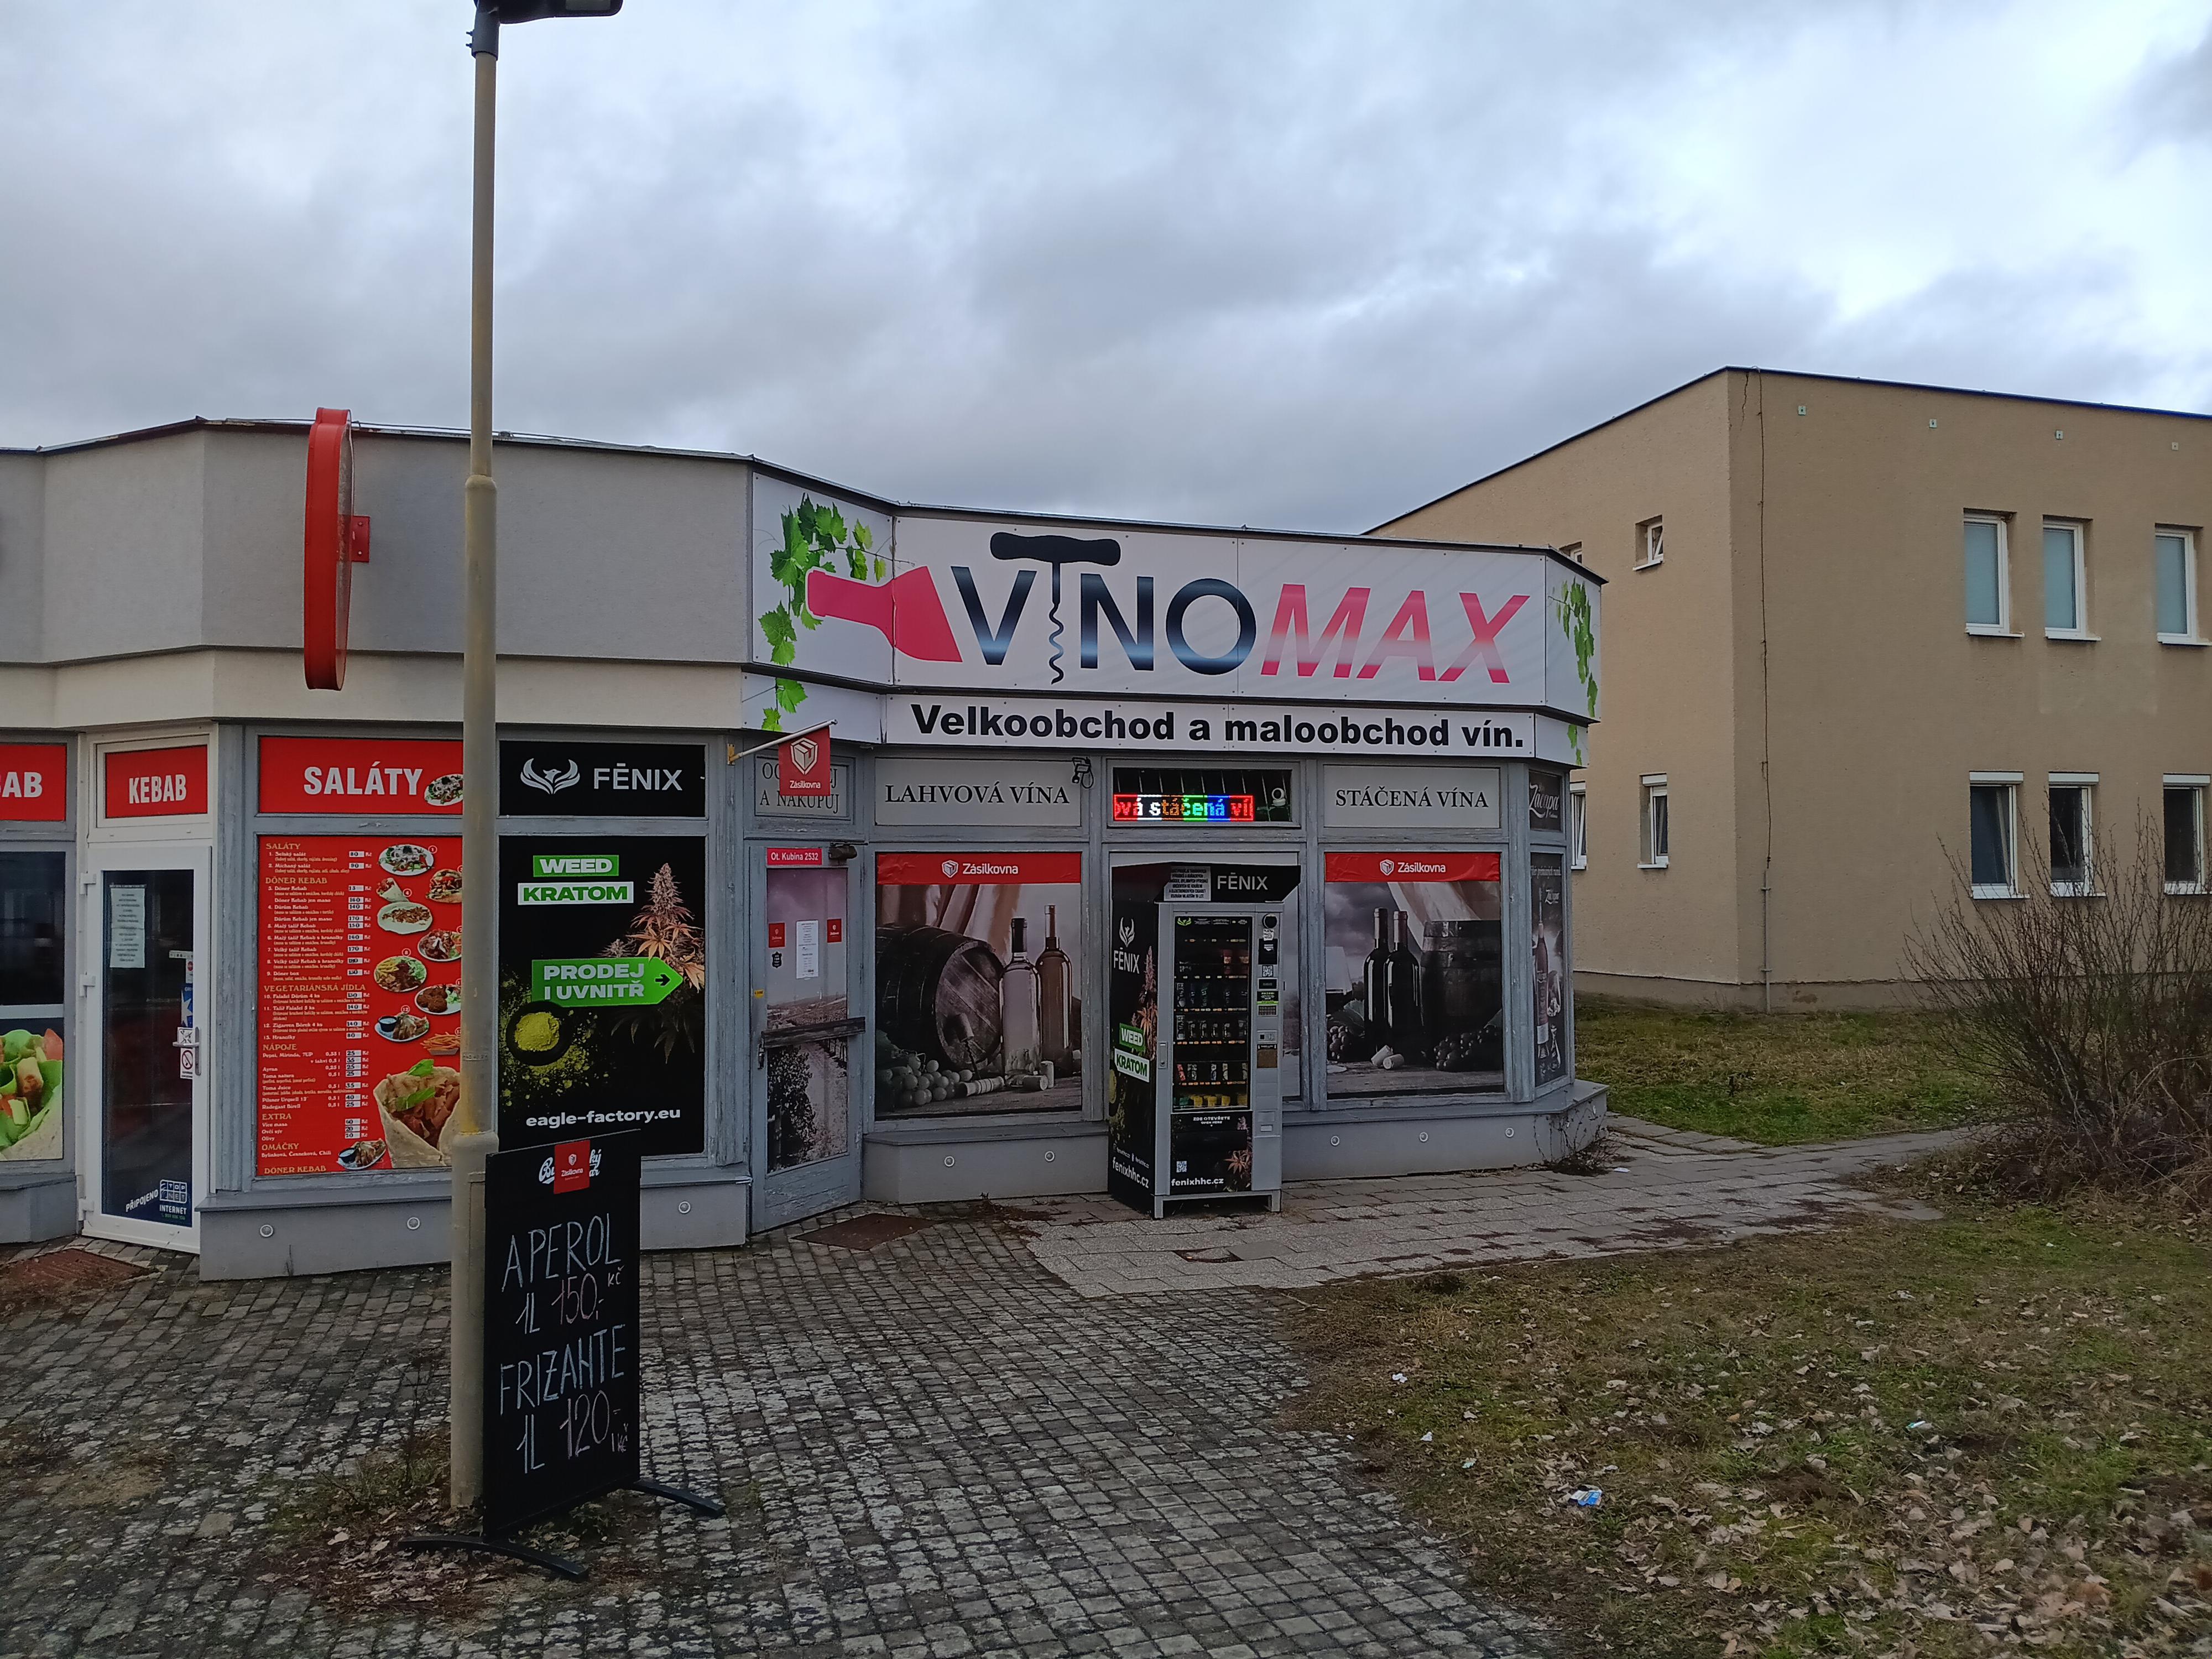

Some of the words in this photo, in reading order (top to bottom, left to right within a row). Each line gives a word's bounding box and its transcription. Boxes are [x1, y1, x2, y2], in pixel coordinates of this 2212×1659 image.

[910, 703, 1175, 740] Velkoobchod
[1188, 719, 1211, 741] a
[1225, 714, 1449, 746] maloobchod
[1462, 720, 1523, 748] vín.
[0, 771, 43, 798] AB
[304, 761, 423, 795] SALÁTY
[790, 780, 821, 789] Zásilkovna
[129, 774, 187, 804] KEBAB
[885, 781, 1005, 804] LAHVOVÁ
[1009, 782, 1070, 804] VÍNA
[1335, 786, 1432, 807] STÁČENÁ
[1437, 787, 1489, 808] VÍNA
[1149, 797, 1225, 816] stáčená
[539, 858, 613, 874] WEED
[771, 852, 780, 860] Ot.
[962, 863, 1019, 875] Zásilkovna
[1397, 862, 1446, 873] Zásilkovna
[523, 886, 628, 902] KRATOM
[544, 963, 645, 980] PRODEJ
[264, 983, 338, 992] VEGETARIÁNSKÁ
[544, 985, 551, 1000] I
[557, 980, 644, 1000] UVNITŘ
[1121, 1027, 1143, 1047] WEED
[1117, 1053, 1148, 1077] KRATOM
[526, 1108, 681, 1129] eagle-factory.eu
[262, 1142, 299, 1151] OMÁČKY
[1113, 1156, 1149, 1189] fenixhhc.cz
[1171, 1177, 1224, 1186] fenixhhc.cz
[126, 1189, 159, 1212] PŘIPOJENO
[159, 1204, 187, 1214] INTERNET
[502, 1213, 622, 1292] APEROL
